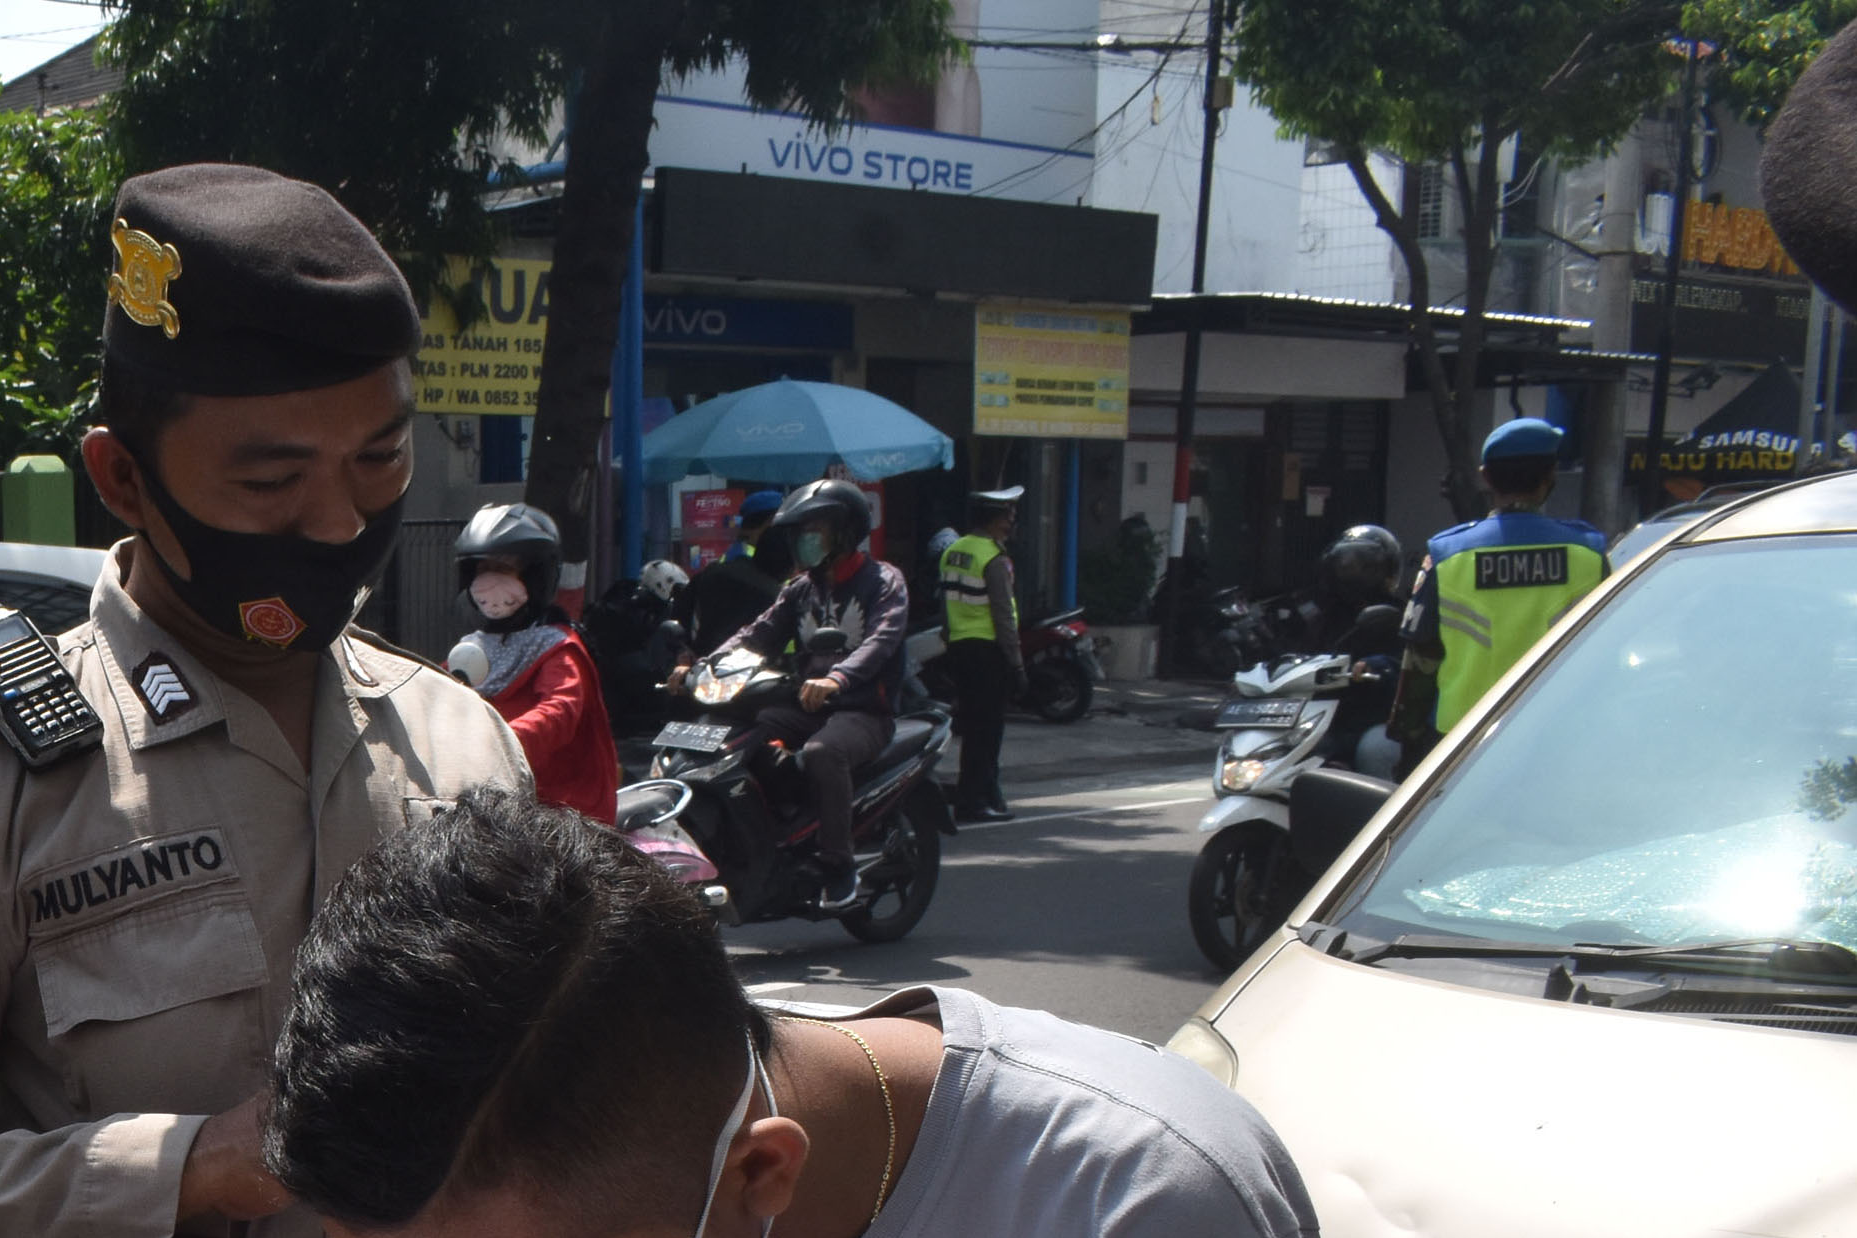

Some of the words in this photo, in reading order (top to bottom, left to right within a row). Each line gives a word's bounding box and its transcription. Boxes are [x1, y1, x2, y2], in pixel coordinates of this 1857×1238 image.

[863, 150, 973, 190] STORE
[451, 335, 508, 352] TANAH
[460, 362, 489, 378] PLN
[494, 364, 528, 379] 2200
[423, 387, 444, 403] HP
[456, 388, 480, 405] WA
[485, 389, 519, 406] 0852
[1482, 551, 1562, 583] POMAU
[31, 836, 223, 923] MULYANTO
